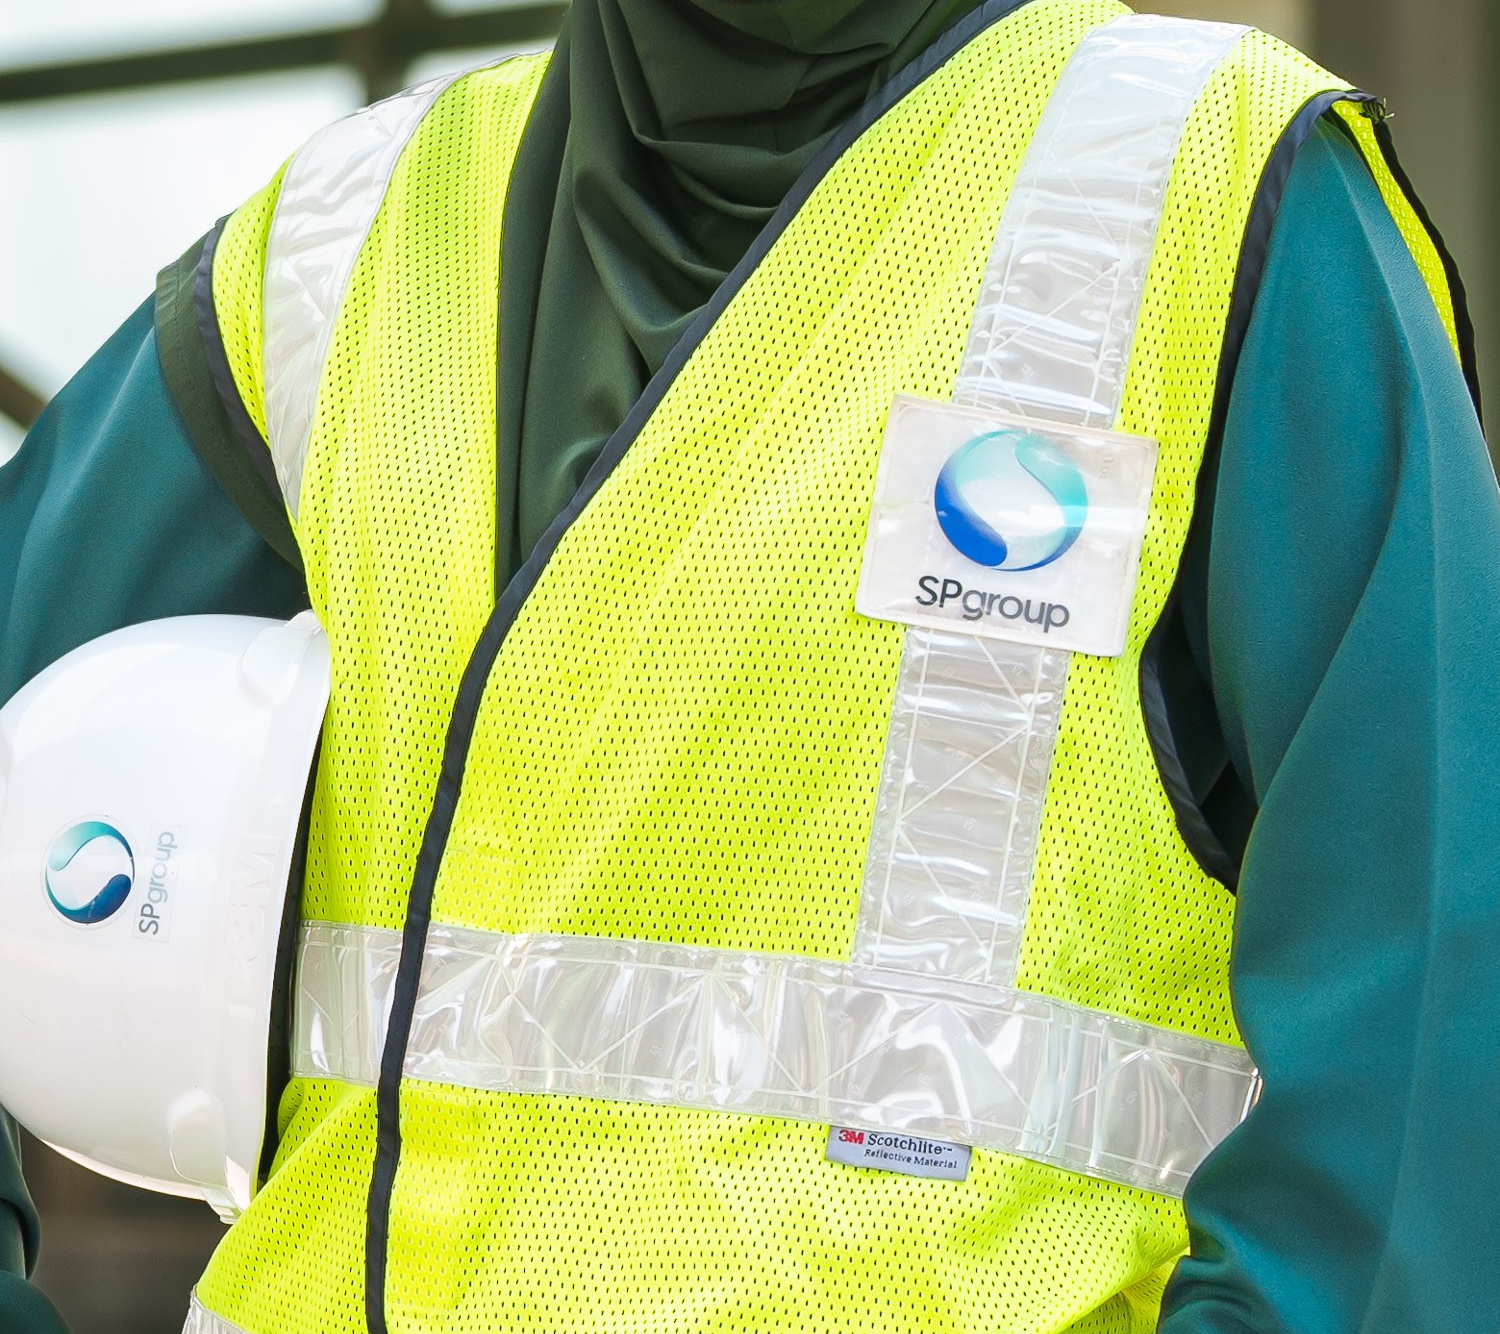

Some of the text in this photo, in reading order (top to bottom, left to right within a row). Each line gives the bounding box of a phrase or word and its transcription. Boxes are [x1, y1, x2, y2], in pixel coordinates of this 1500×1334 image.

[838, 1129, 864, 1145] 3M
[864, 1148, 957, 1169] Reflective Material
